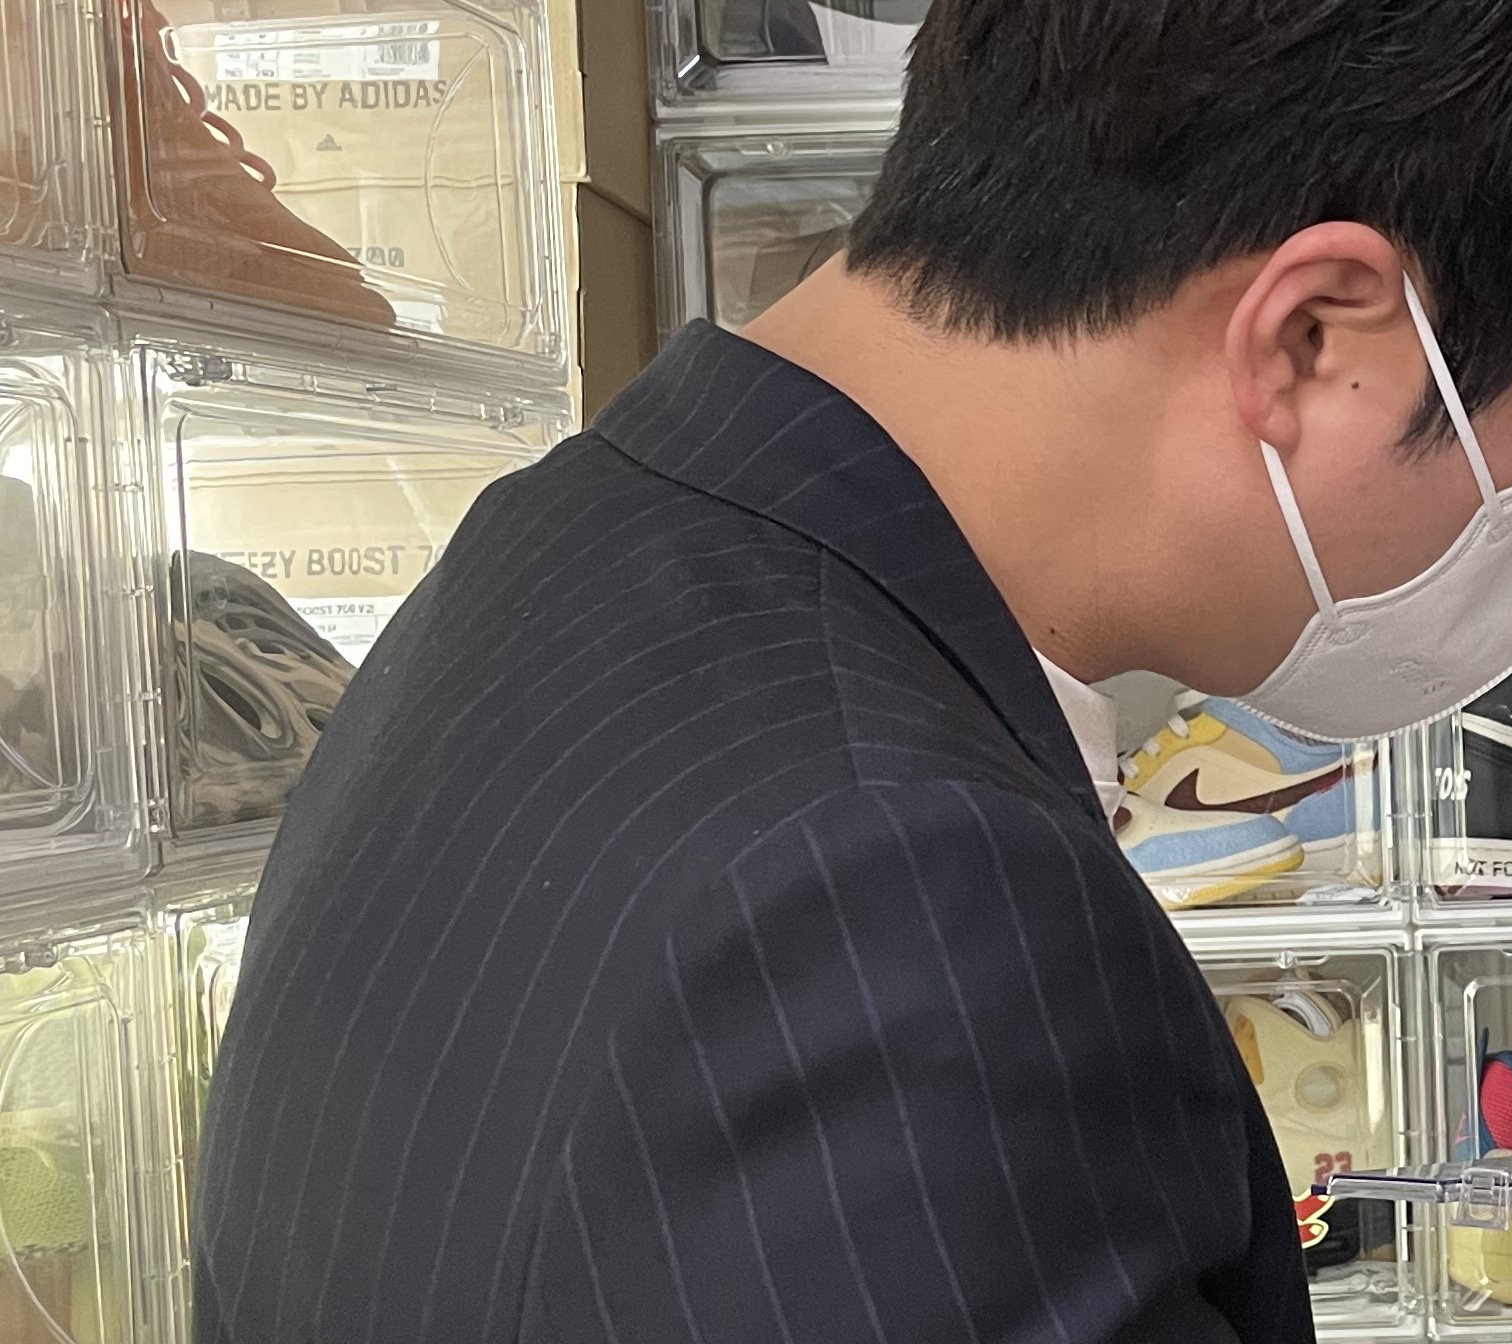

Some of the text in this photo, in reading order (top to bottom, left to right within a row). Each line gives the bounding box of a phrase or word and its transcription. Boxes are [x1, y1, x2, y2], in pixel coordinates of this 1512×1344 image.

[205, 79, 447, 112] MADE BY ADIDAS
[306, 545, 406, 576] BOOST
